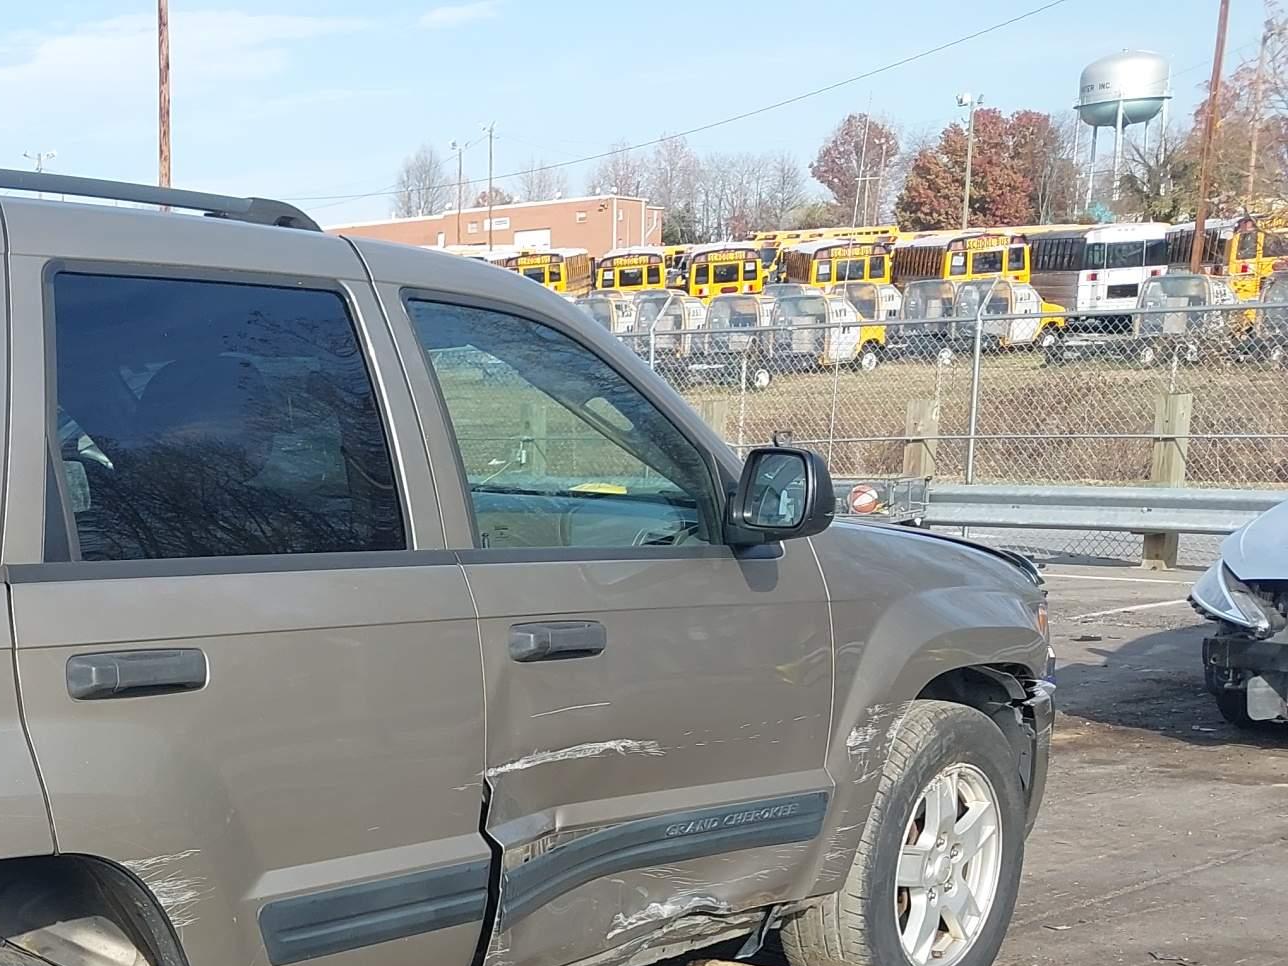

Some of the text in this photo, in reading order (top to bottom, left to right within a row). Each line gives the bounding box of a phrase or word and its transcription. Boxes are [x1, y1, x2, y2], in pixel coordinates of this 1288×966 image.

[967, 236, 1009, 249] SCHOOL BUS
[665, 803, 800, 837] GRAND CHEROKEE
